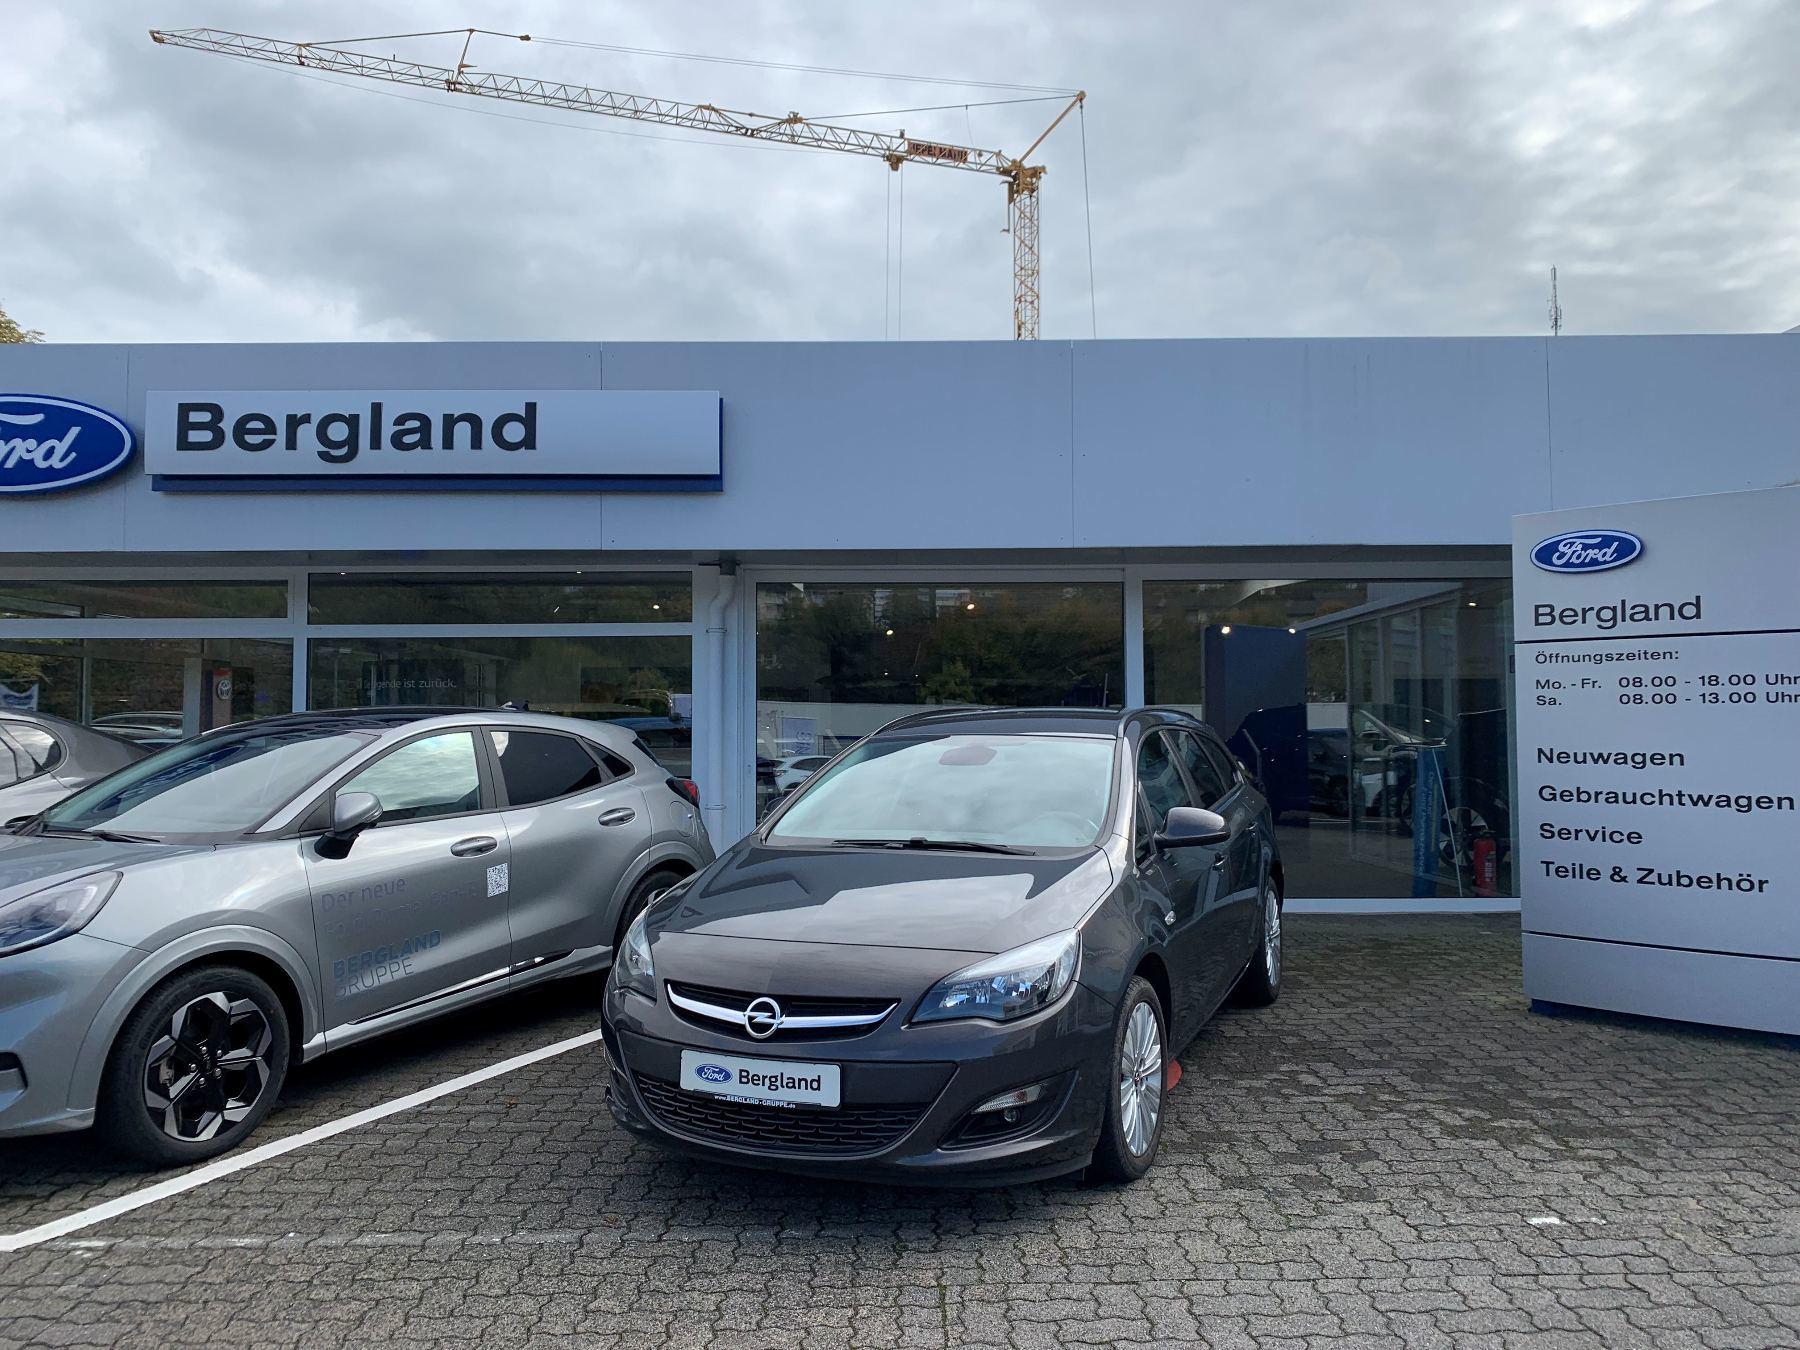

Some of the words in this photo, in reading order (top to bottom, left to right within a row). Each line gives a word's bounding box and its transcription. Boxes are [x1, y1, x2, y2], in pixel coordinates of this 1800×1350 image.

[175, 402, 537, 464] Bergland
[1552, 537, 1620, 566] Ford
[1533, 595, 1702, 630] Bergland
[1535, 650, 1679, 665] Öffnungszeiten:
[1618, 676, 1677, 688] 08.00
[1698, 674, 1757, 687] 18.00
[1765, 673, 1800, 686] Uhr
[1536, 695, 1563, 706] Sa.
[1619, 693, 1678, 705] 08.00
[1698, 691, 1757, 704] 13.00
[1766, 691, 1800, 704] Uhr
[1537, 747, 1685, 769] Neuwagen
[1538, 784, 1795, 813] Gebrauchtwagen
[1539, 822, 1643, 844] Service
[1540, 860, 1602, 881] Teile
[1609, 866, 1629, 883] &
[1636, 867, 1769, 893] Zubehör
[321, 891, 356, 912] Der
[361, 878, 408, 901] neue
[333, 930, 441, 978] BERGLAND
[701, 1066, 725, 1082] Ford
[738, 1069, 822, 1092] Bergland
